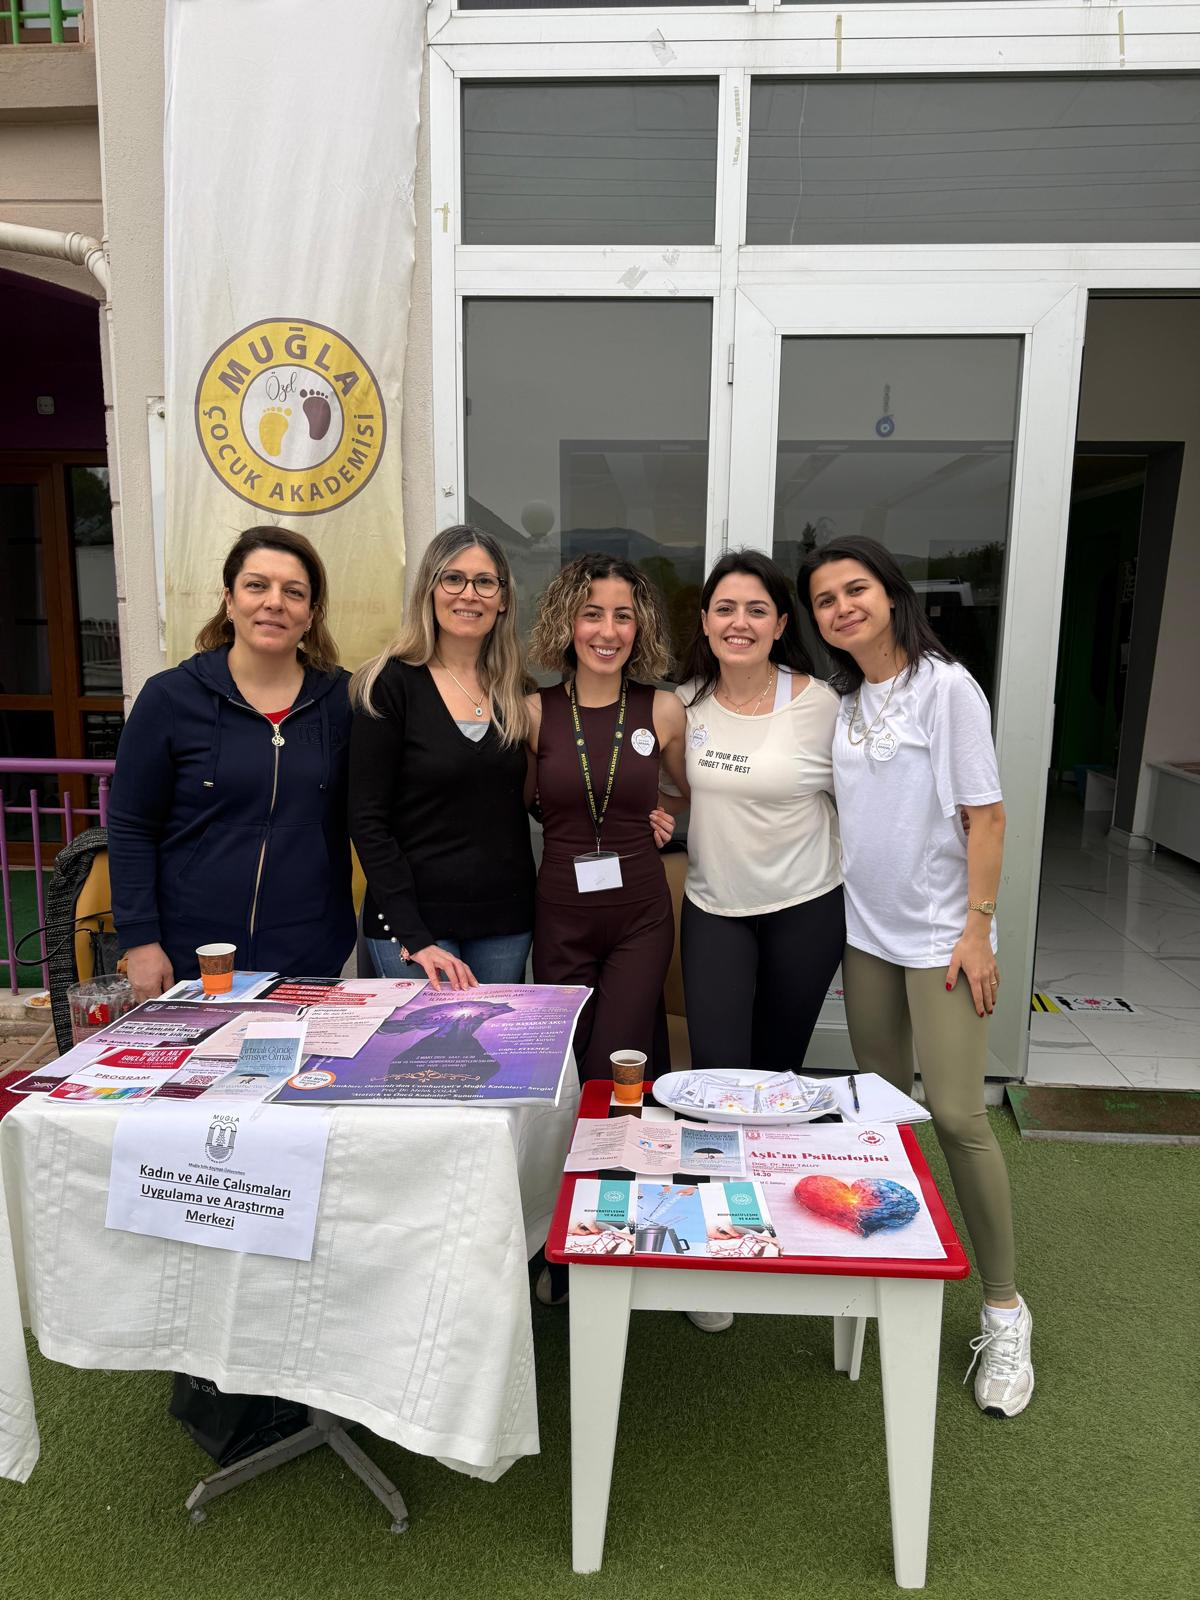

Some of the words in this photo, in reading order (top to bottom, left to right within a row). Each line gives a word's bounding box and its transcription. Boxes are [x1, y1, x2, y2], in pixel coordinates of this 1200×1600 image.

[217, 326, 360, 397] MUĞLA
[265, 371, 297, 402] Özel
[202, 406, 265, 491] ÇOCUK
[270, 413, 376, 503] AKADEMİSİ
[698, 758, 720, 768] FORGET
[721, 763, 733, 772] THE
[734, 765, 751, 774] REST
[715, 752, 732, 761] YOUR
[732, 754, 748, 763] BEST
[802, 1152, 890, 1163] Psikolojisi
[140, 1164, 174, 1180] Kadın
[178, 1171, 192, 1182] ve
[196, 1172, 220, 1187] Aile
[223, 1177, 291, 1198] Çalışmaları
[142, 1184, 202, 1204] Uygulama
[206, 1194, 220, 1205] ve
[224, 1196, 284, 1217] Araştırma
[186, 1210, 235, 1228] Merkezi
